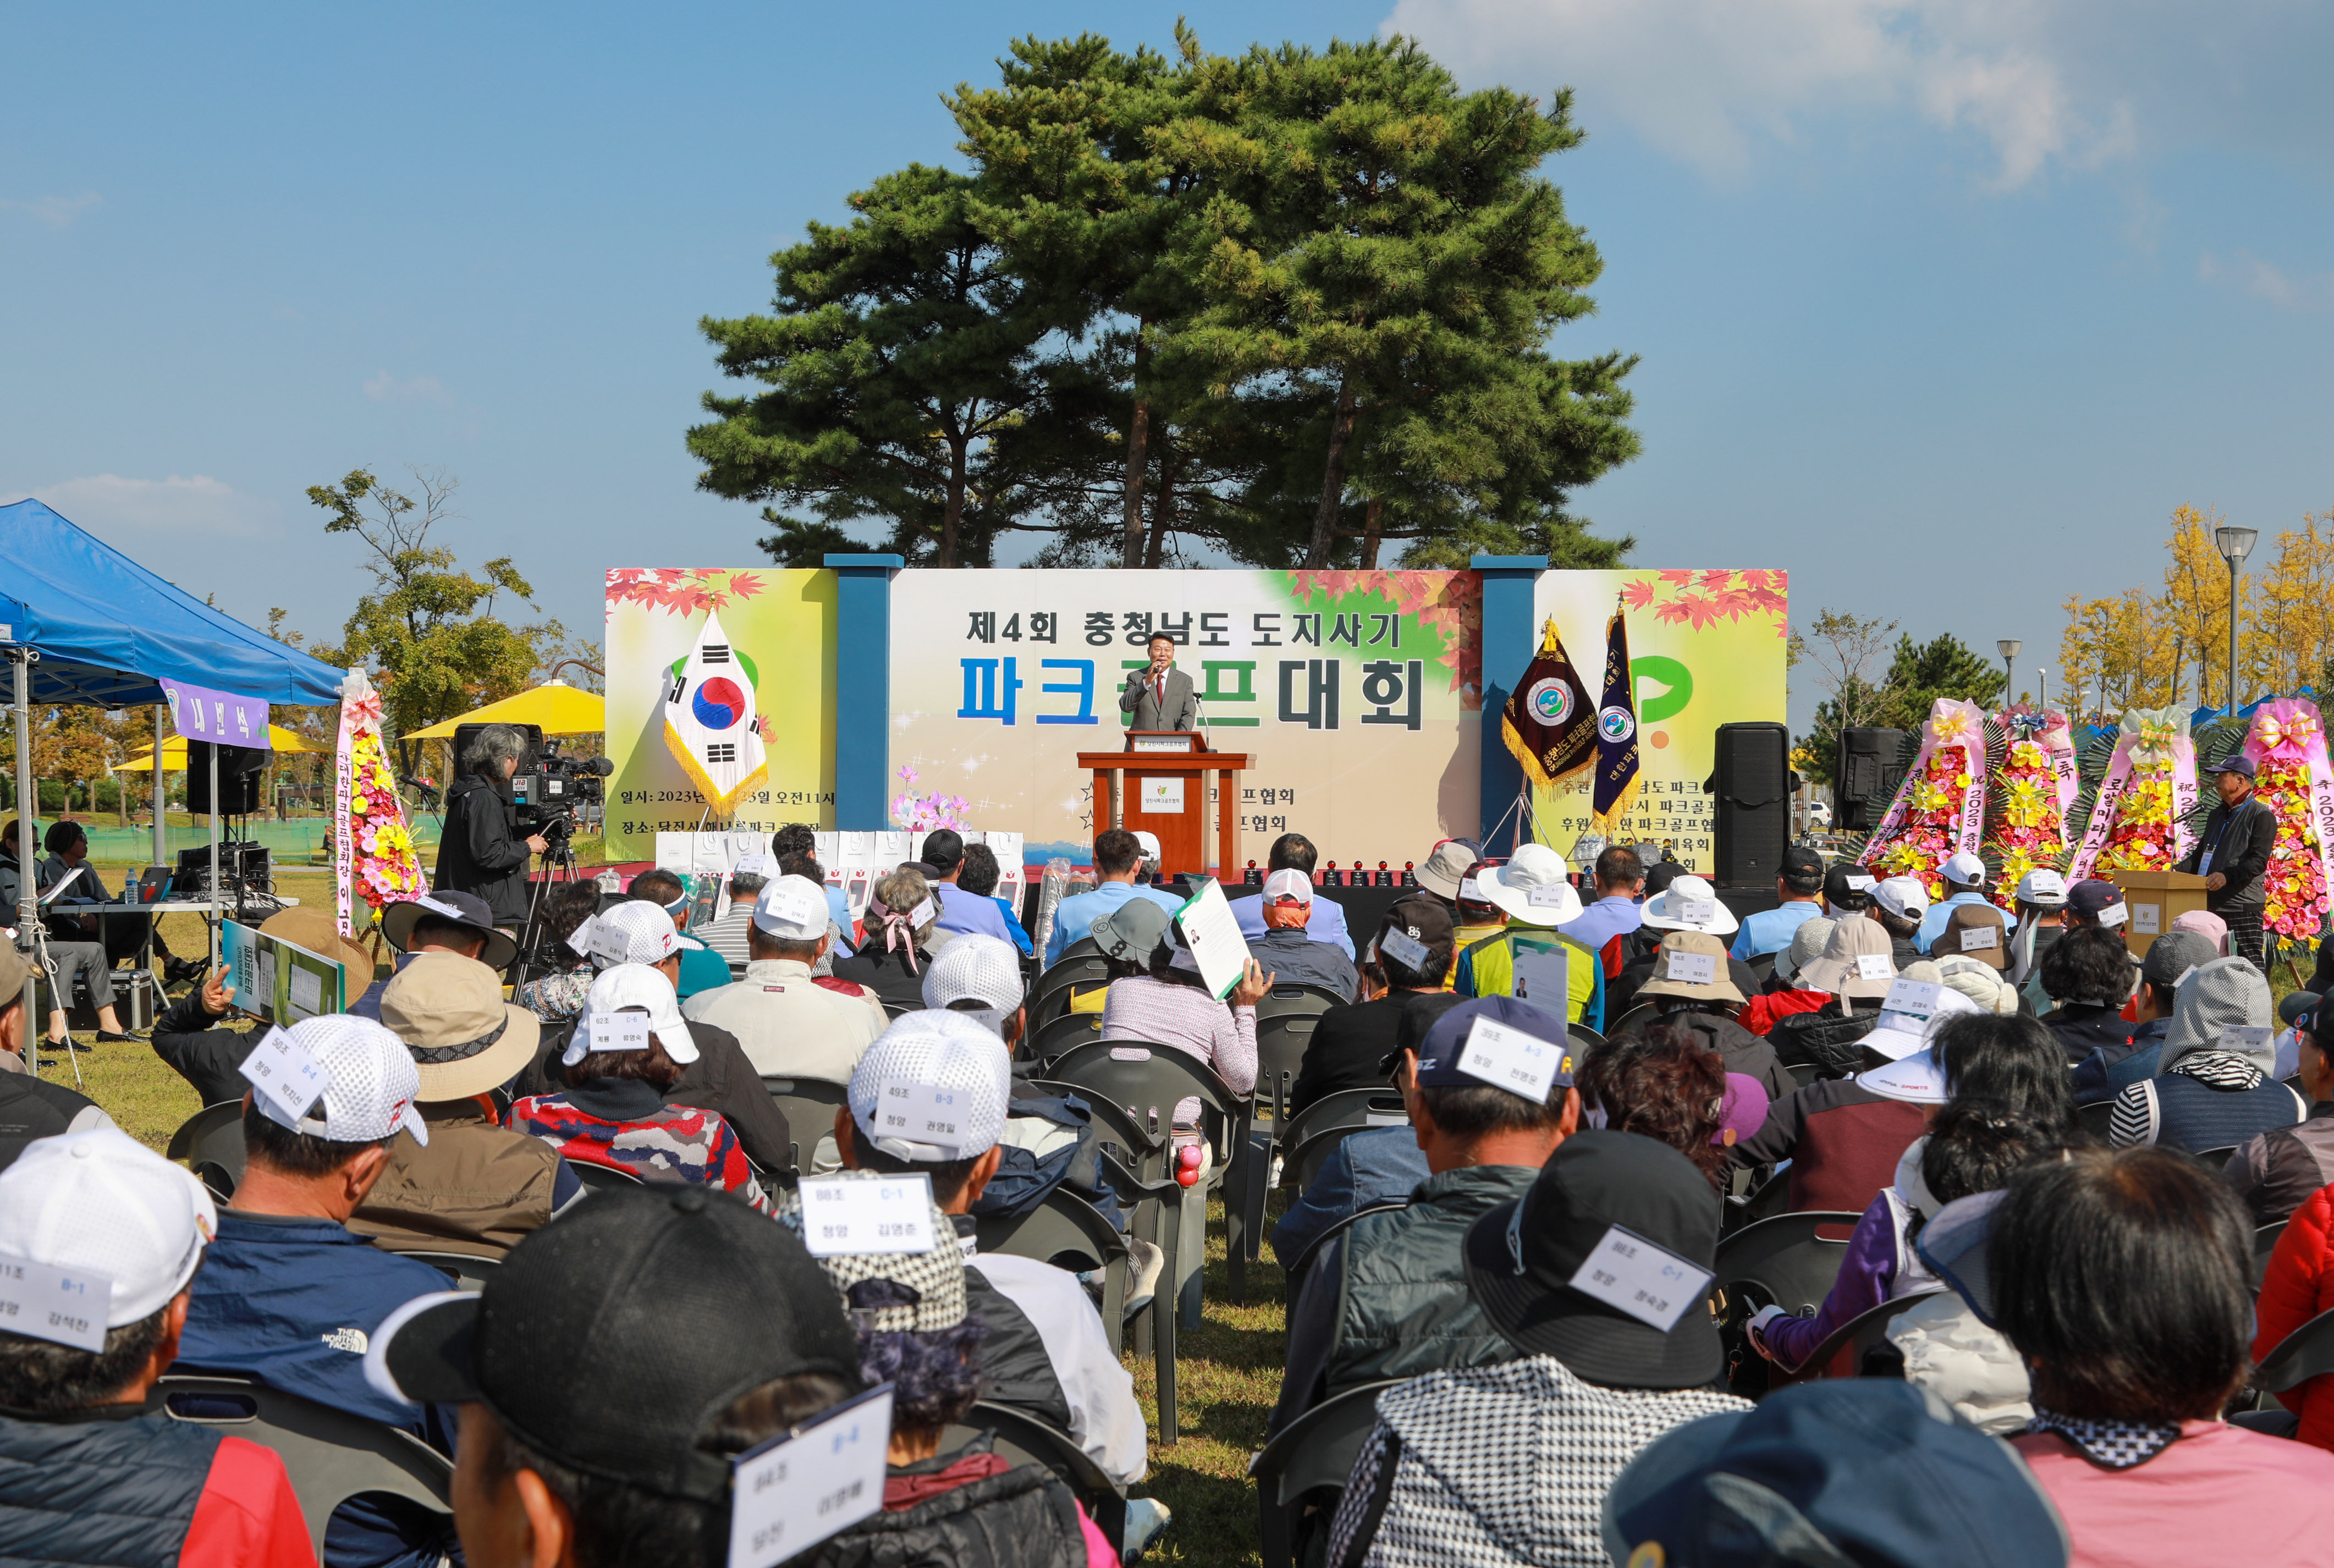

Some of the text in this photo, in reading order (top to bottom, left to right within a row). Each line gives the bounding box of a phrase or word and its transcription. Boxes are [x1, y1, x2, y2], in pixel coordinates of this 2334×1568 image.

[966, 612, 1399, 648] 제4회 충청남도 도지사기
[957, 656, 1423, 731] 파크프대회
[190, 698, 250, 739] 내빈석
[1543, 739, 1572, 767] 충청남도
[2057, 761, 2074, 782] 축
[2177, 782, 2197, 793] 祝
[621, 790, 653, 804] 일시:
[776, 791, 835, 806] 오전11시
[1962, 774, 1985, 855] 祝 2023 충청
[2181, 797, 2193, 836] 203
[2319, 795, 2334, 837] 2023
[622, 822, 653, 834] 장소:
[1561, 818, 1589, 832] 후원
[1638, 818, 1715, 832] 파크골프협
[2072, 859, 2089, 879] 대표
[244, 945, 254, 996] 파크골프대회
[1480, 1027, 1502, 1042] 39조
[271, 1037, 317, 1080] 50조 B-4
[254, 1059, 271, 1077] 청양
[888, 1086, 953, 1105] 49조 B-3
[887, 1114, 906, 1127] 청양
[881, 1187, 904, 1200] C-1
[61, 1278, 85, 1294] B-1
[322, 1333, 353, 1344] NORTH
[337, 1328, 355, 1336] THE
[328, 1341, 354, 1352] FACE
